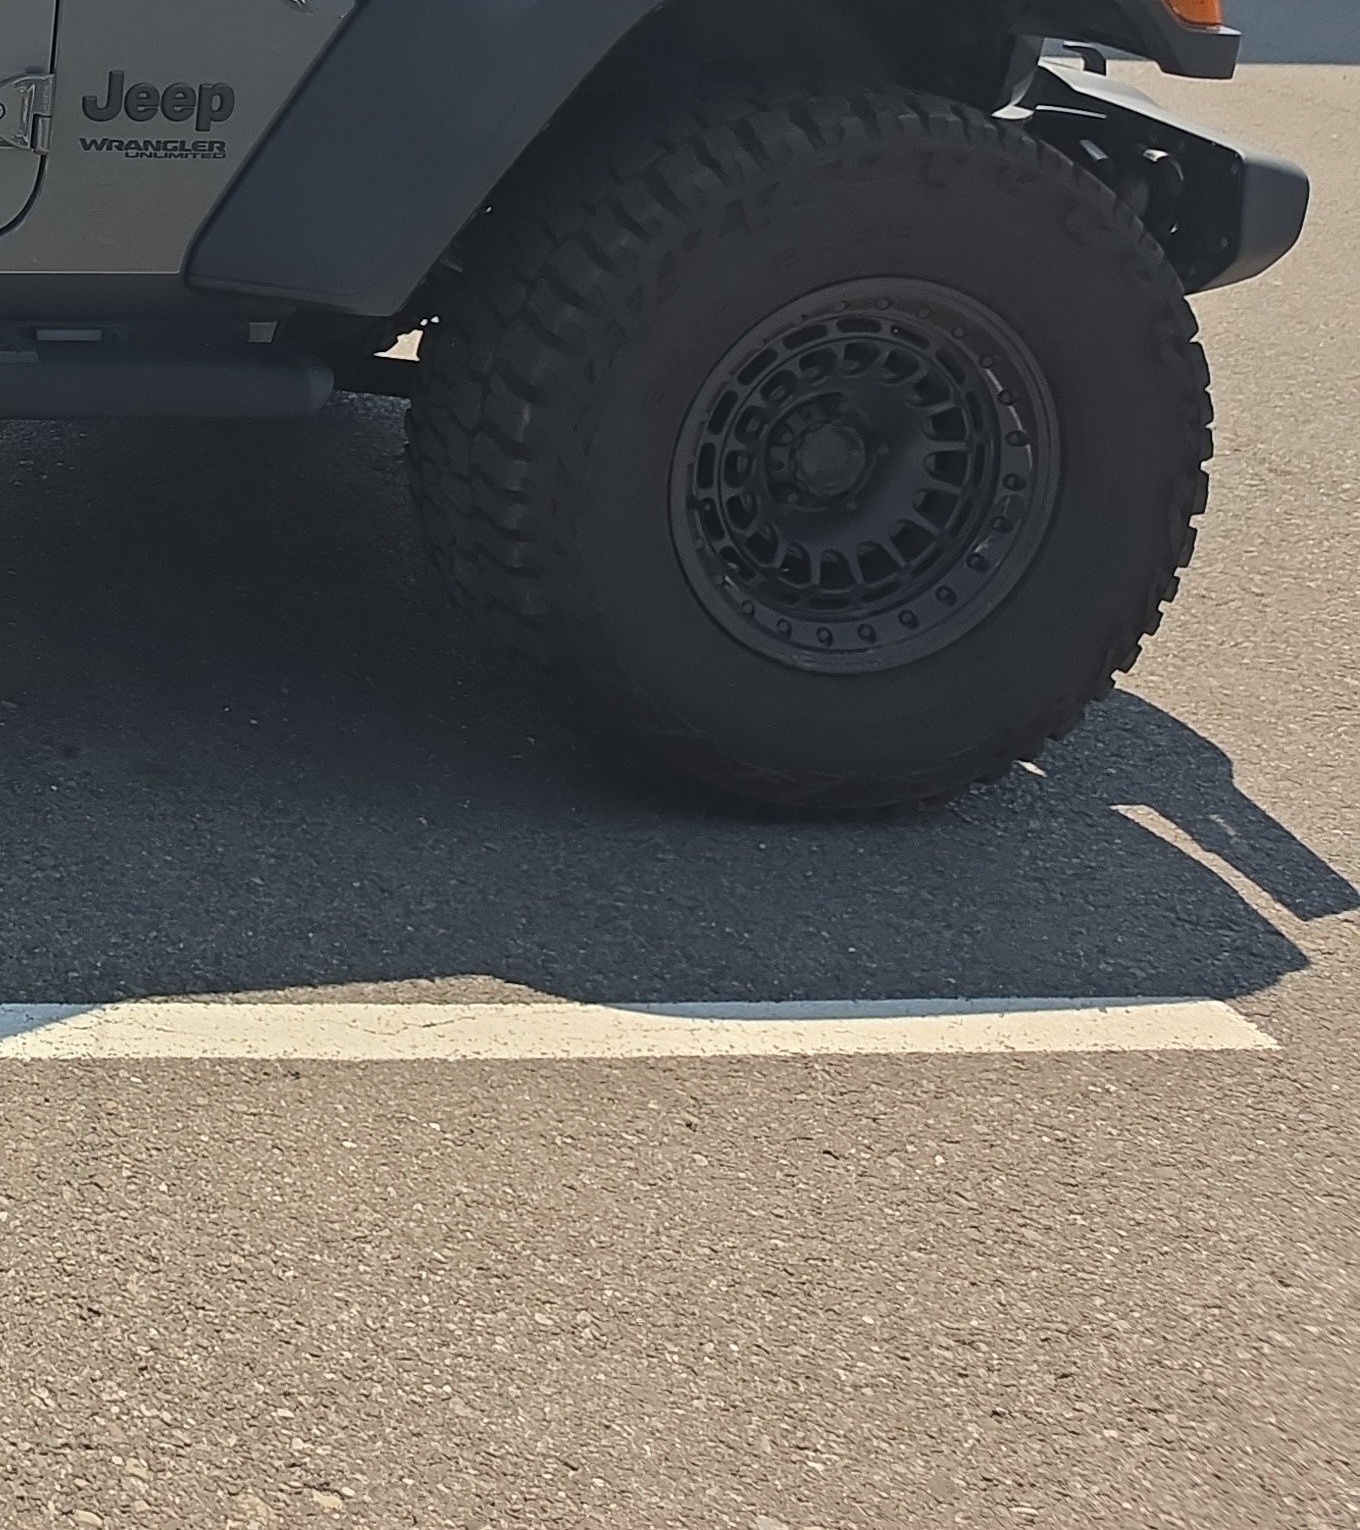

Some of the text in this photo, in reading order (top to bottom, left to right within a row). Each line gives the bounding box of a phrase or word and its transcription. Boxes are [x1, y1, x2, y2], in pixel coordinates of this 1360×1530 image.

[81, 69, 235, 132] Jeep
[78, 137, 227, 153] WRANGLER
[124, 151, 227, 160] UNLIMITED
